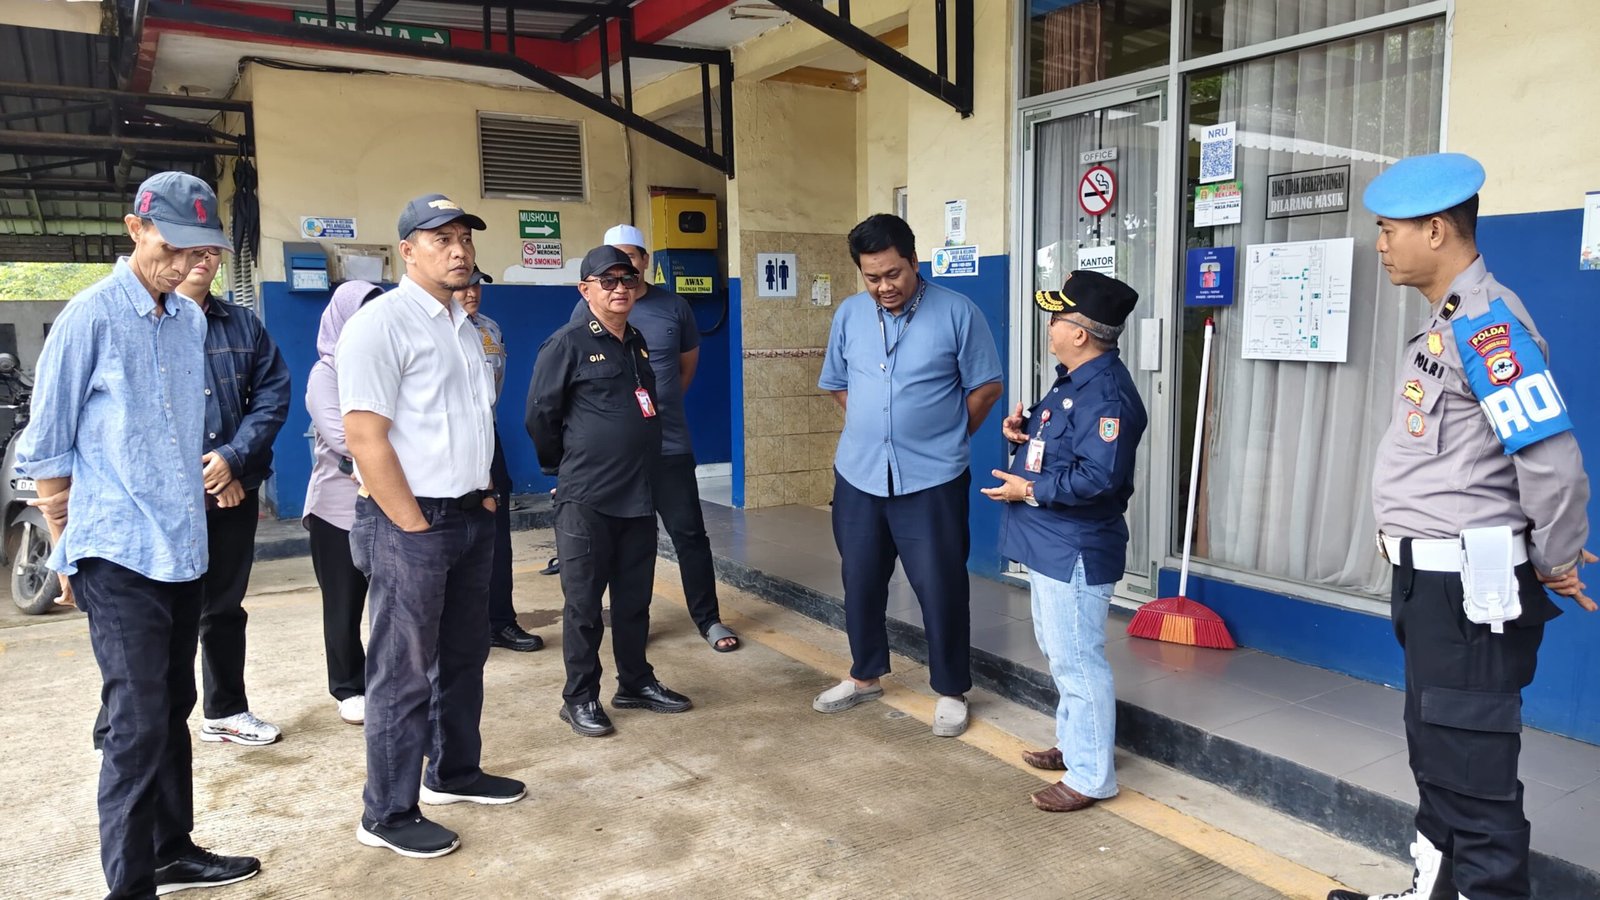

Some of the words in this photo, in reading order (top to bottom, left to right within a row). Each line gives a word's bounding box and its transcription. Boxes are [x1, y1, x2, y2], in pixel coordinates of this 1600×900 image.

[1208, 127, 1228, 139] NRU
[1083, 150, 1113, 162] OFFICE
[1271, 180, 1284, 197] YANG
[1285, 178, 1300, 195] TIDAK
[1270, 195, 1313, 213] DILARANG
[1314, 192, 1344, 209] MASUK
[520, 212, 559, 223] MUSHOLLA
[524, 257, 533, 265] NO
[534, 258, 561, 266] SMOKING
[1080, 256, 1113, 267] KANTOR
[684, 278, 704, 286] AWAS
[1471, 326, 1506, 346] POLDA
